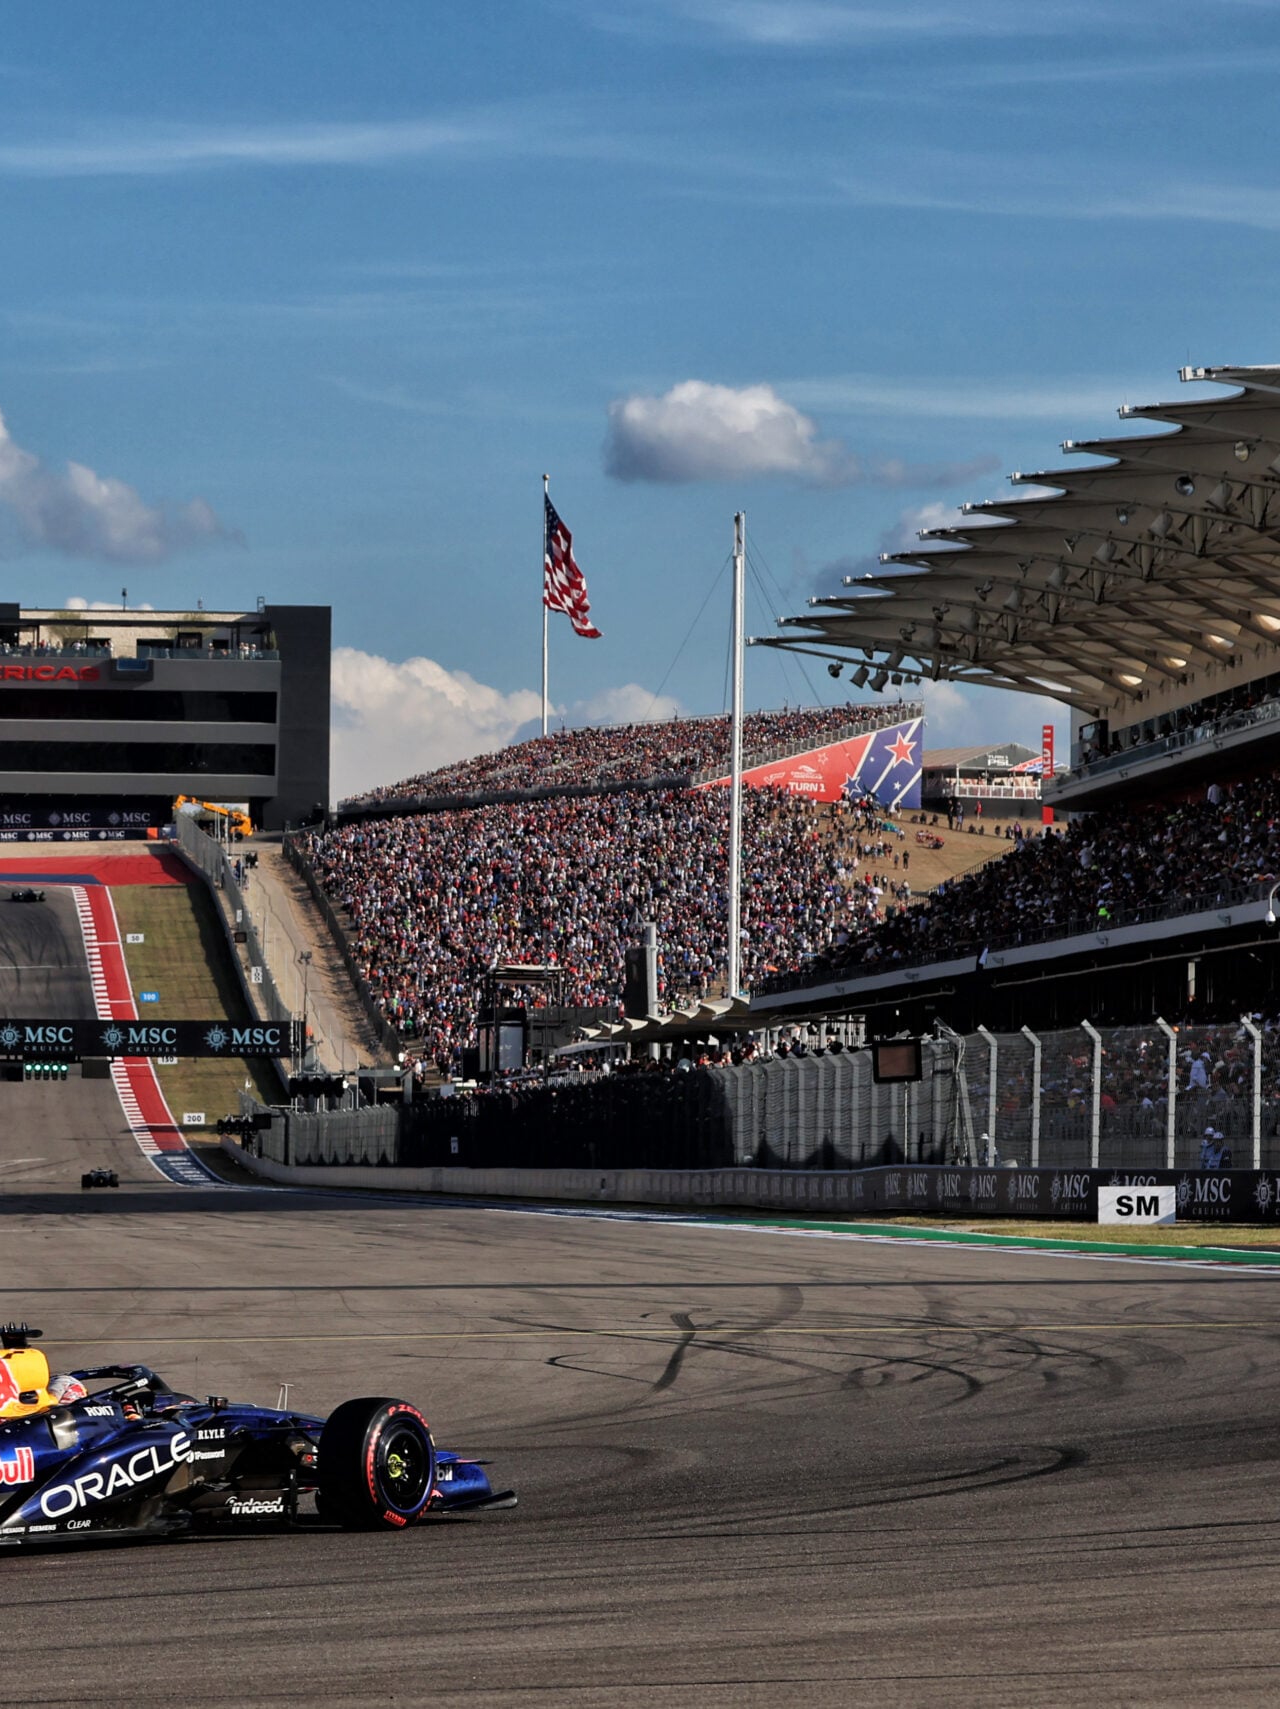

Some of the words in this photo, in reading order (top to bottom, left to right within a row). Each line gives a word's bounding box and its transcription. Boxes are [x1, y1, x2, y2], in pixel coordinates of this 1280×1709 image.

[788, 781, 818, 792] TURN
[819, 783, 826, 792] 1
[3, 813, 31, 824] MSC
[62, 812, 91, 823] MSC
[122, 812, 151, 823] MSC
[142, 993, 156, 1001] 100
[24, 1026, 74, 1044] MSC
[128, 1027, 177, 1045] MSC
[231, 1028, 281, 1046] MSC
[187, 1114, 202, 1123] 200
[944, 1174, 960, 1197] MSC
[978, 1175, 997, 1198] MSC
[1017, 1175, 1039, 1198] MSC
[1062, 1174, 1089, 1198] MSC
[1193, 1178, 1231, 1202] MSC
[1116, 1195, 1159, 1217] SM
[197, 1428, 225, 1440] RLYLE
[40, 1431, 193, 1518] ORACLE
[436, 1464, 453, 1481] bil
[231, 1496, 284, 1515] indeed
[66, 1519, 92, 1530] CLEAR
